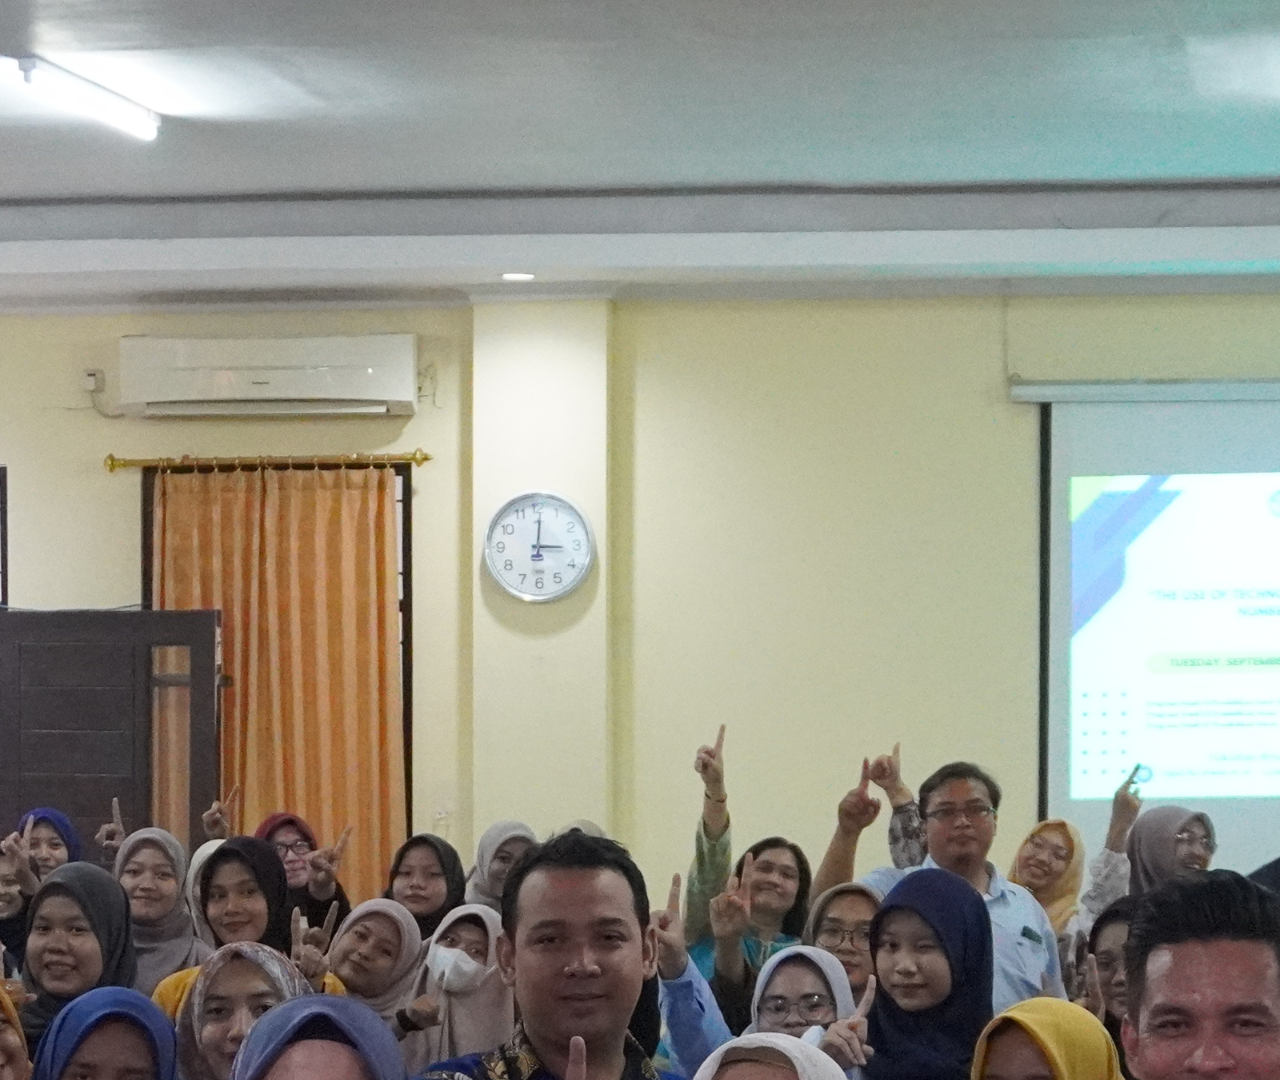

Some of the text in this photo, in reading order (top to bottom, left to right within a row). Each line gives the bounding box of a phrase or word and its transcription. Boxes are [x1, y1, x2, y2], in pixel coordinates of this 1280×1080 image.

[515, 508, 526, 519] 11
[501, 524, 515, 535] 10
[566, 521, 575, 533] 2
[496, 541, 505, 553] 9
[572, 540, 581, 551] 3
[504, 559, 513, 571] 8
[567, 558, 576, 569] 4
[518, 573, 527, 584] 7
[535, 577, 544, 589] 6
[553, 572, 563, 584] 5
